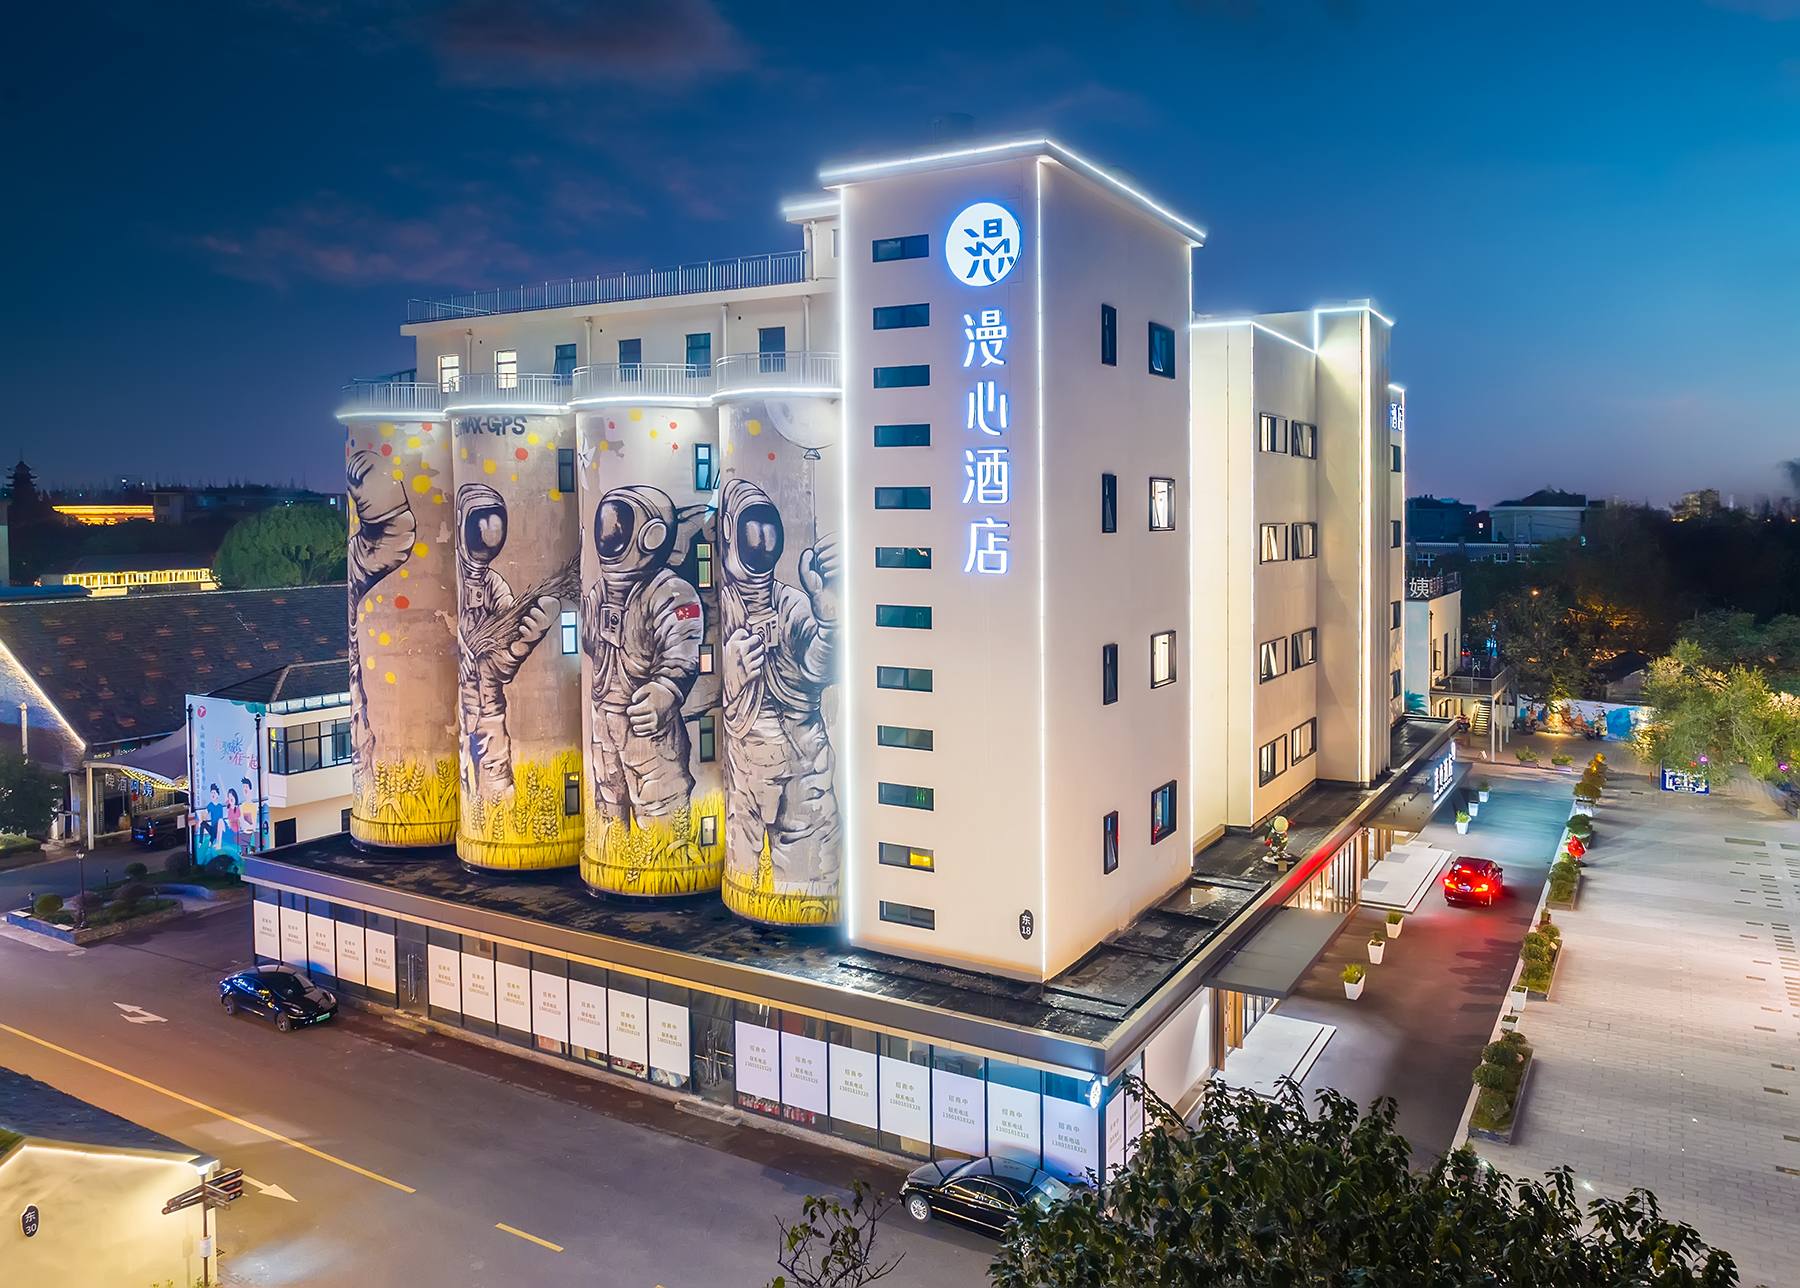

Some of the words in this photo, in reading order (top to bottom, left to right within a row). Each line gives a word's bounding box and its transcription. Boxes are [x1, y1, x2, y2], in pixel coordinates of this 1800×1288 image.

[962, 309, 1010, 575] 漫心酒店
[1021, 915, 1031, 925] 东
[1021, 926, 1032, 935] 18
[25, 1211, 36, 1223] 东
[25, 1223, 37, 1235] 30
